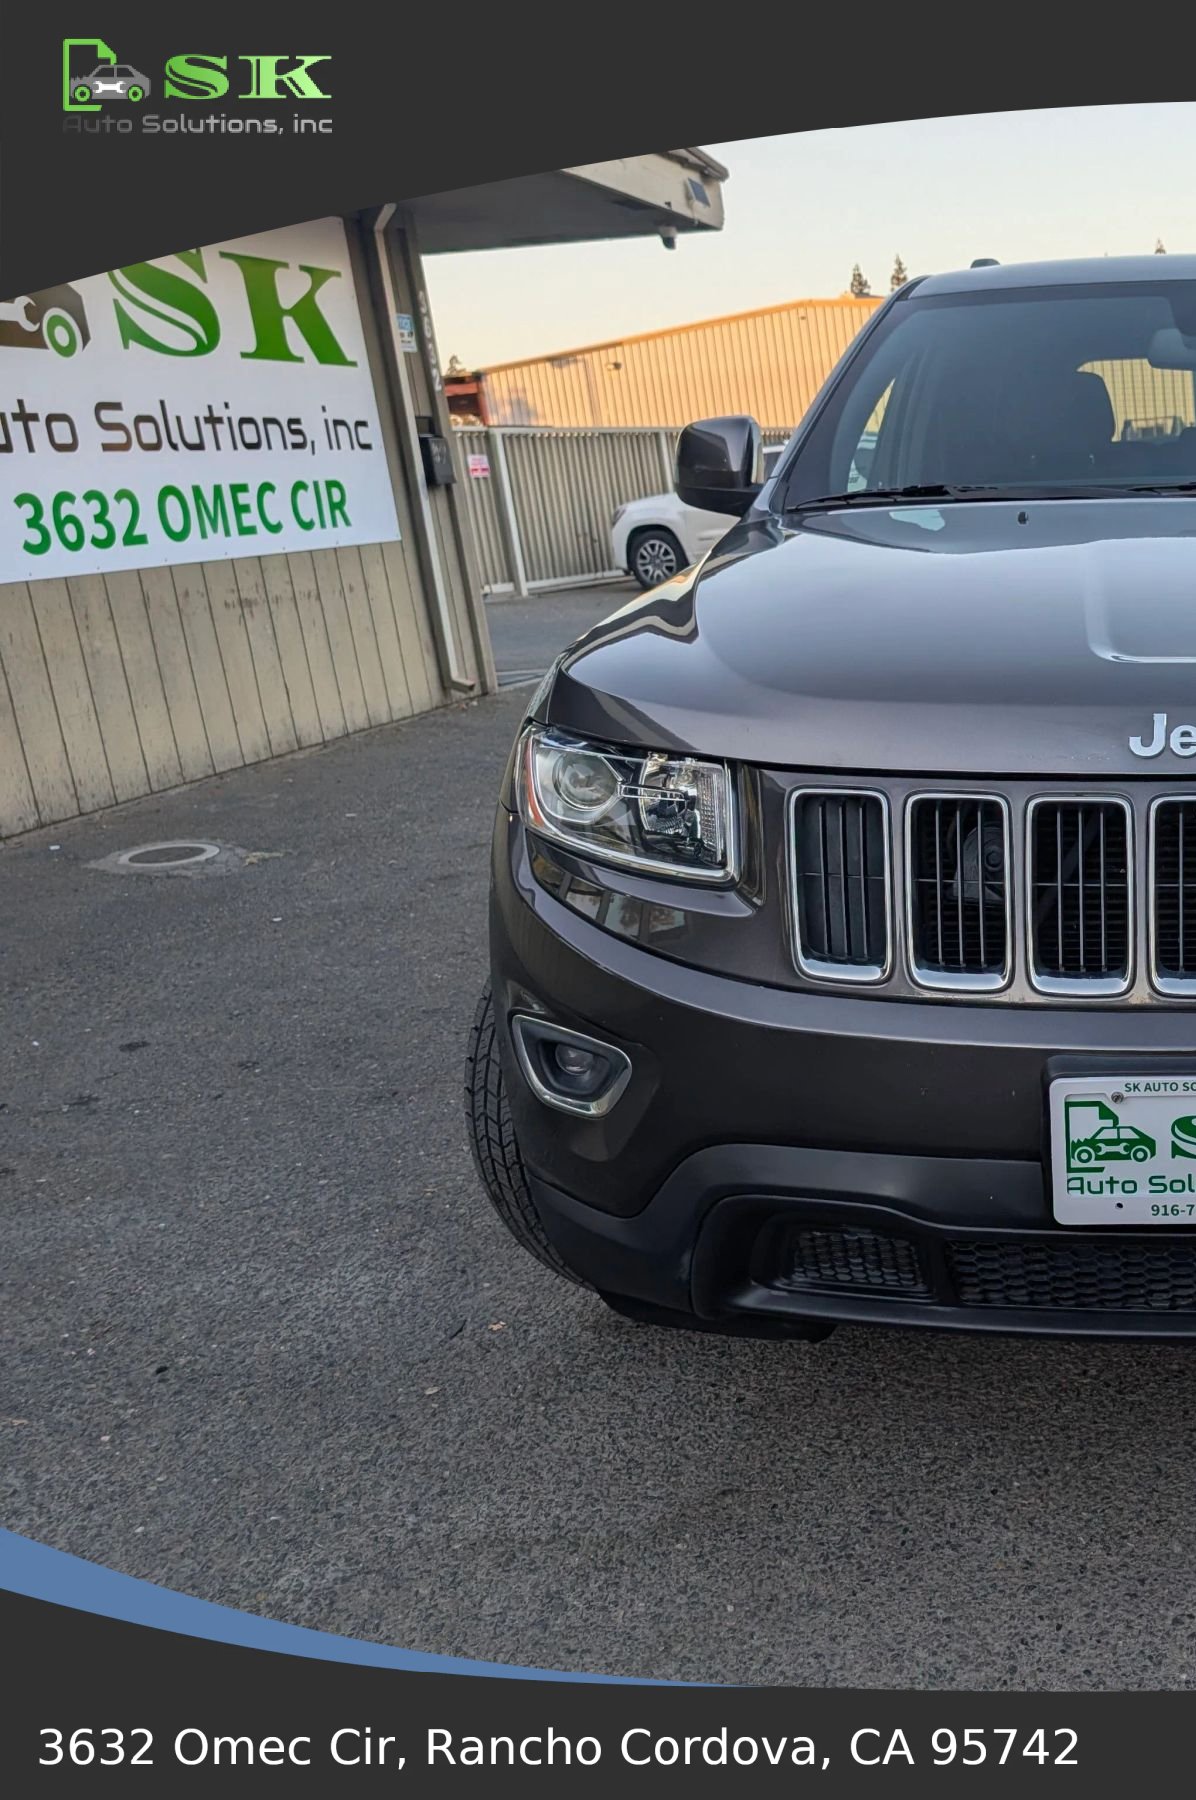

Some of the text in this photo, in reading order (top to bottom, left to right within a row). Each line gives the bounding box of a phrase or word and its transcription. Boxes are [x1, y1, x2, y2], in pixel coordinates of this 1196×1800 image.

[107, 247, 358, 367] SK
[0, 398, 373, 456] to Solutions, inc
[14, 479, 352, 556] 3632 OMEC CIR
[1124, 1082, 1142, 1092] SK
[1144, 1082, 1179, 1092] AUTO
[1066, 1175, 1138, 1195] Auto
